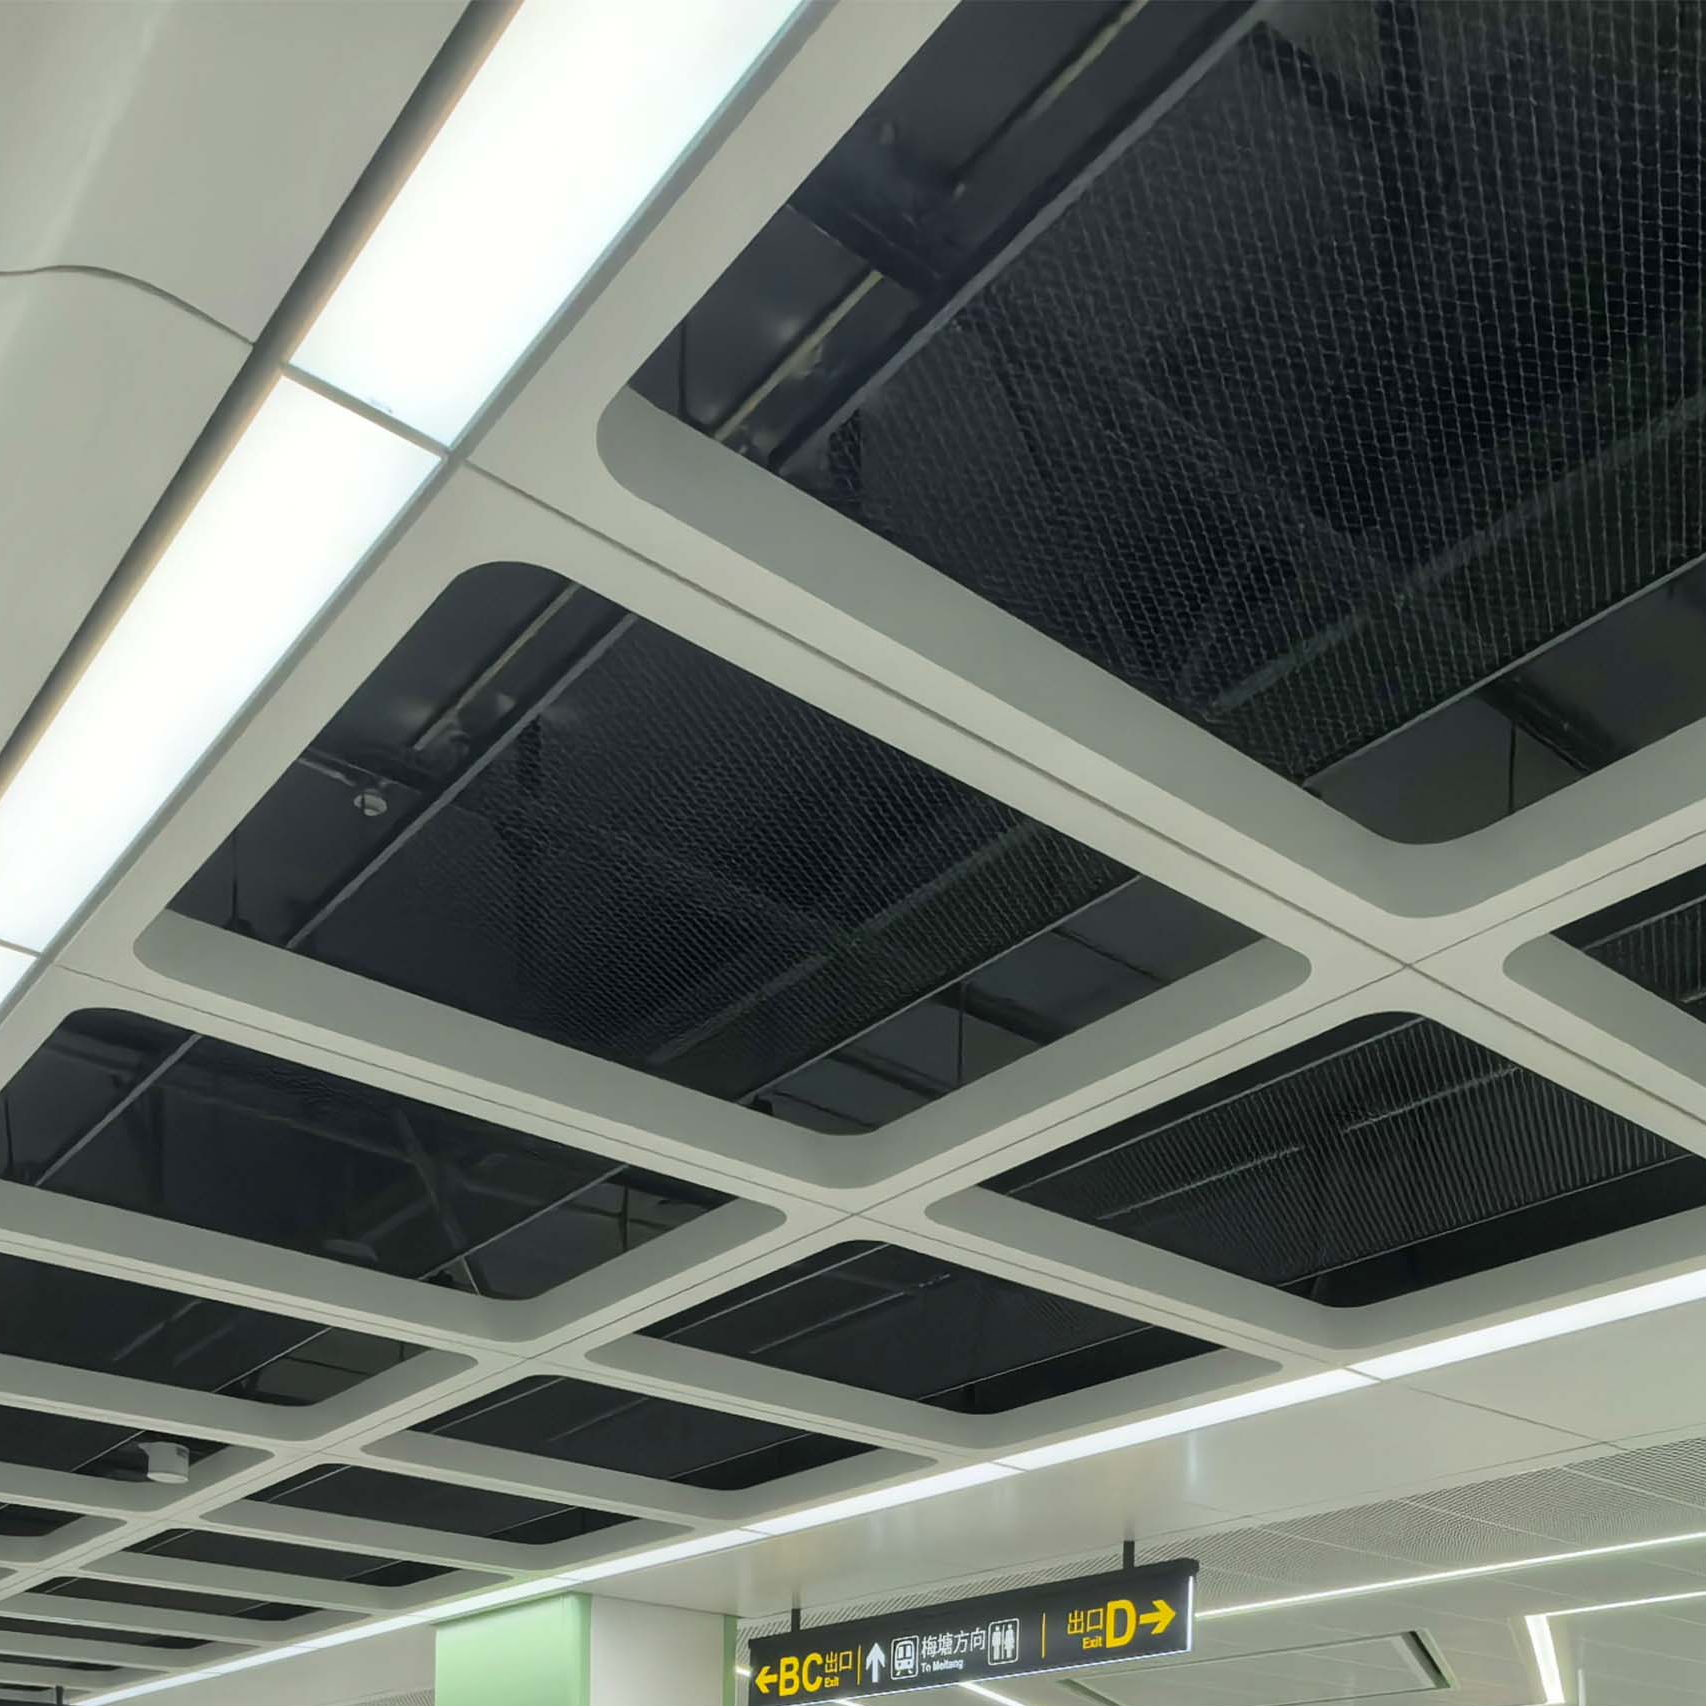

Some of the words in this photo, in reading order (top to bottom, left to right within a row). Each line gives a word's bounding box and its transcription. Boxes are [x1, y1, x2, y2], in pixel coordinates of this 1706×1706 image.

[1067, 1608, 1104, 1635] 出口
[1106, 1599, 1137, 1649] D
[921, 1627, 987, 1657] 梅塘方向
[1082, 1635, 1104, 1650] Exit
[778, 1652, 824, 1697] BC
[825, 1650, 853, 1674] 出口
[921, 1662, 931, 1673] To
